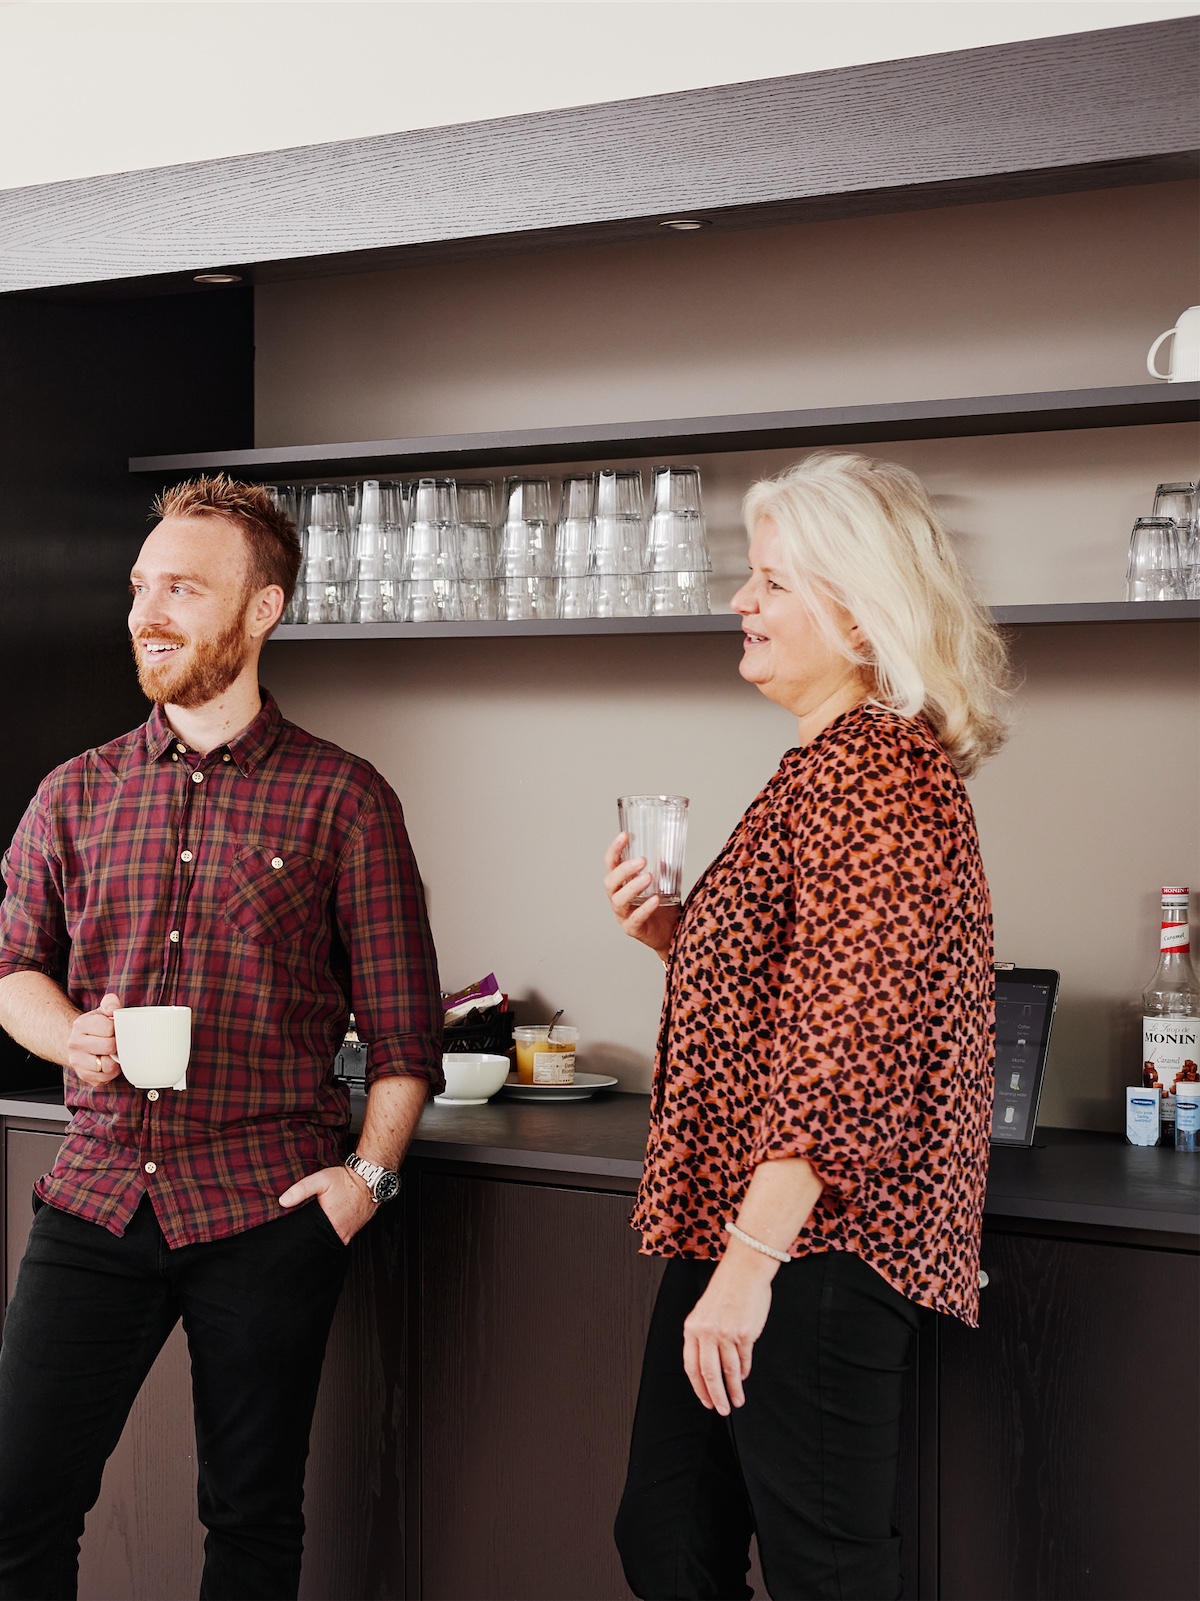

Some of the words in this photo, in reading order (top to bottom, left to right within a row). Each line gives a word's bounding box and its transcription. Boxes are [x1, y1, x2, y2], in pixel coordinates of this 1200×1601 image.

[1164, 932, 1184, 941] Caramel
[1160, 1023, 1180, 1034] Sirop
[1145, 1032, 1196, 1044] MONIN
[1157, 1055, 1181, 1064] Caramel
